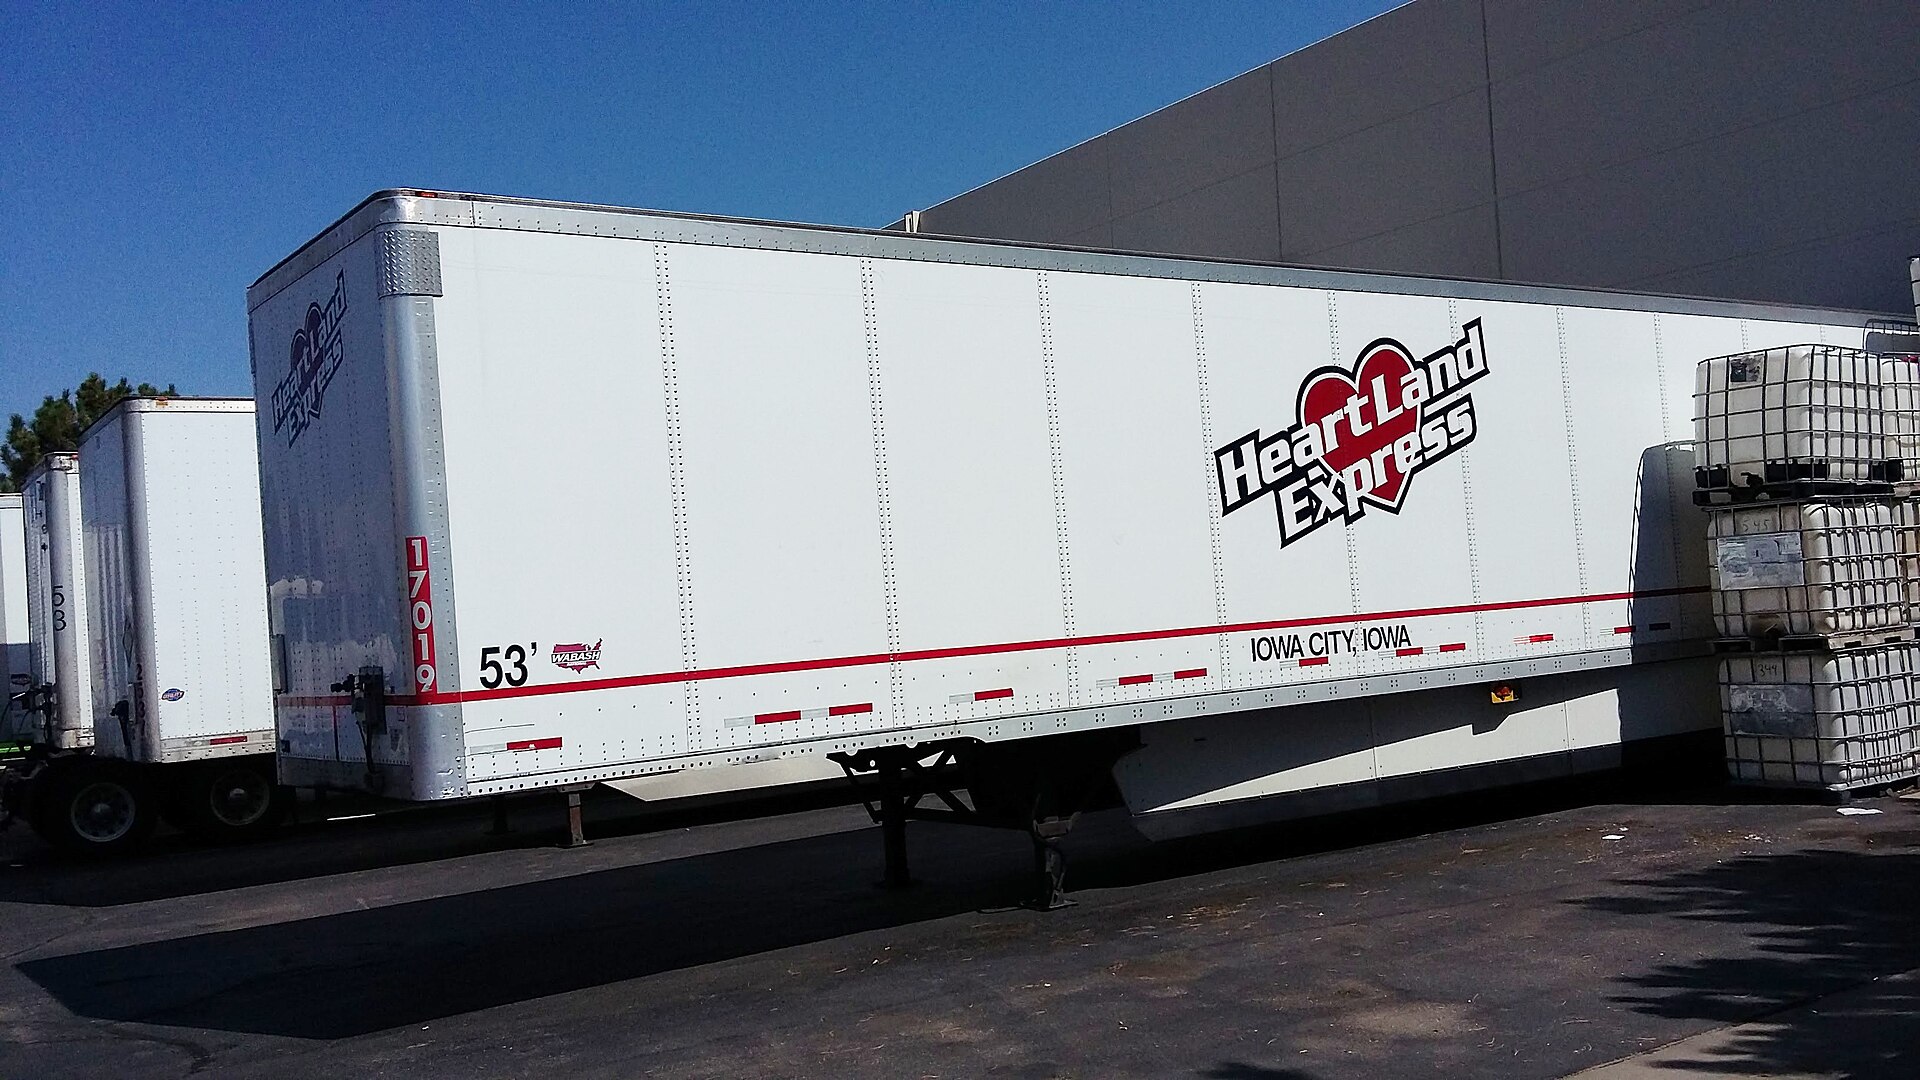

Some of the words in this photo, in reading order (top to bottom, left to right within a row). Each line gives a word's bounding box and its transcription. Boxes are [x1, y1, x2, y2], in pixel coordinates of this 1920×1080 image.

[1216, 320, 1489, 511] HeartLand
[1276, 399, 1475, 543] Express
[408, 538, 436, 693] 17019
[552, 651, 601, 662] WABASH
[1250, 634, 1305, 662] IOWA
[1308, 628, 1358, 657] CITY,
[1362, 624, 1412, 651] IOWA
